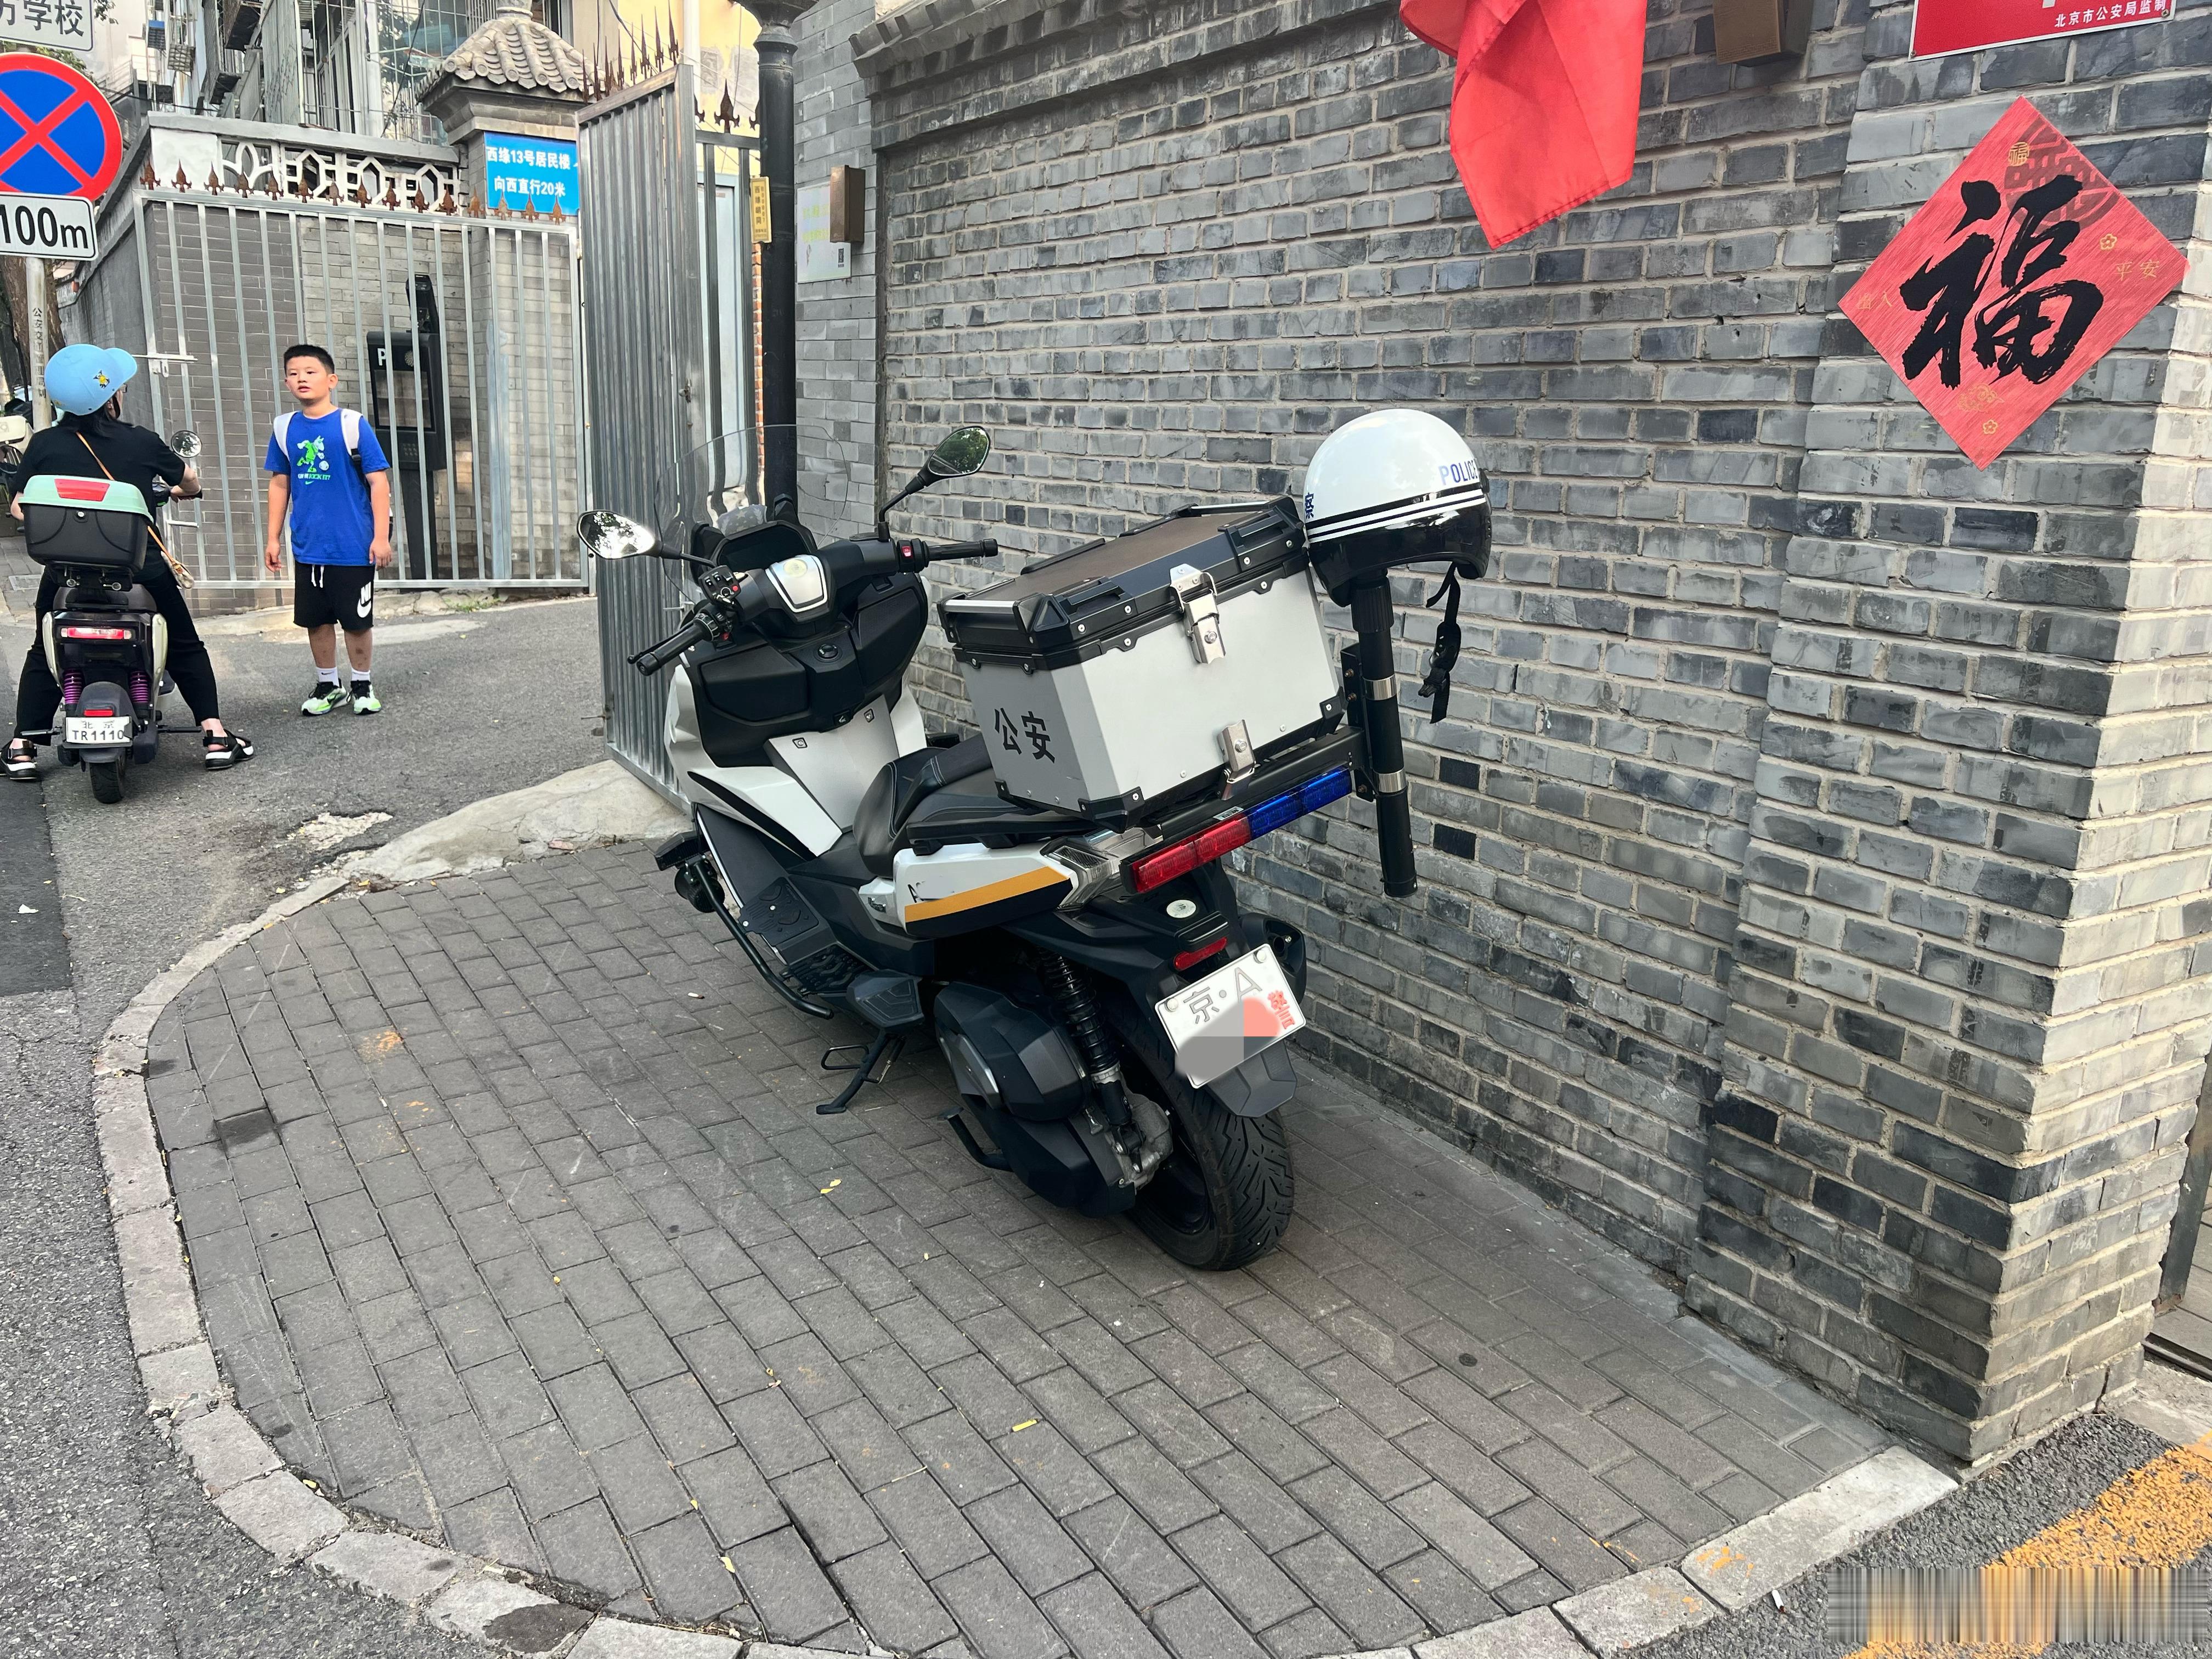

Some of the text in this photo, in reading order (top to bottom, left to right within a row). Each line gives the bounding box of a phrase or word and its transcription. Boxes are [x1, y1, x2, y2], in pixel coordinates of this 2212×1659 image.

[2054, 0, 2166, 27] 北京市公安局监制
[494, 175, 566, 197] 向西直行20米
[0, 204, 88, 249] 100m
[1900, 174, 2104, 390] 福
[2115, 259, 2160, 281] 平安
[1438, 459, 1478, 486] POLICE
[72, 730, 124, 741] TR1110
[81, 719, 115, 729] 北京
[994, 708, 1056, 764] 公安
